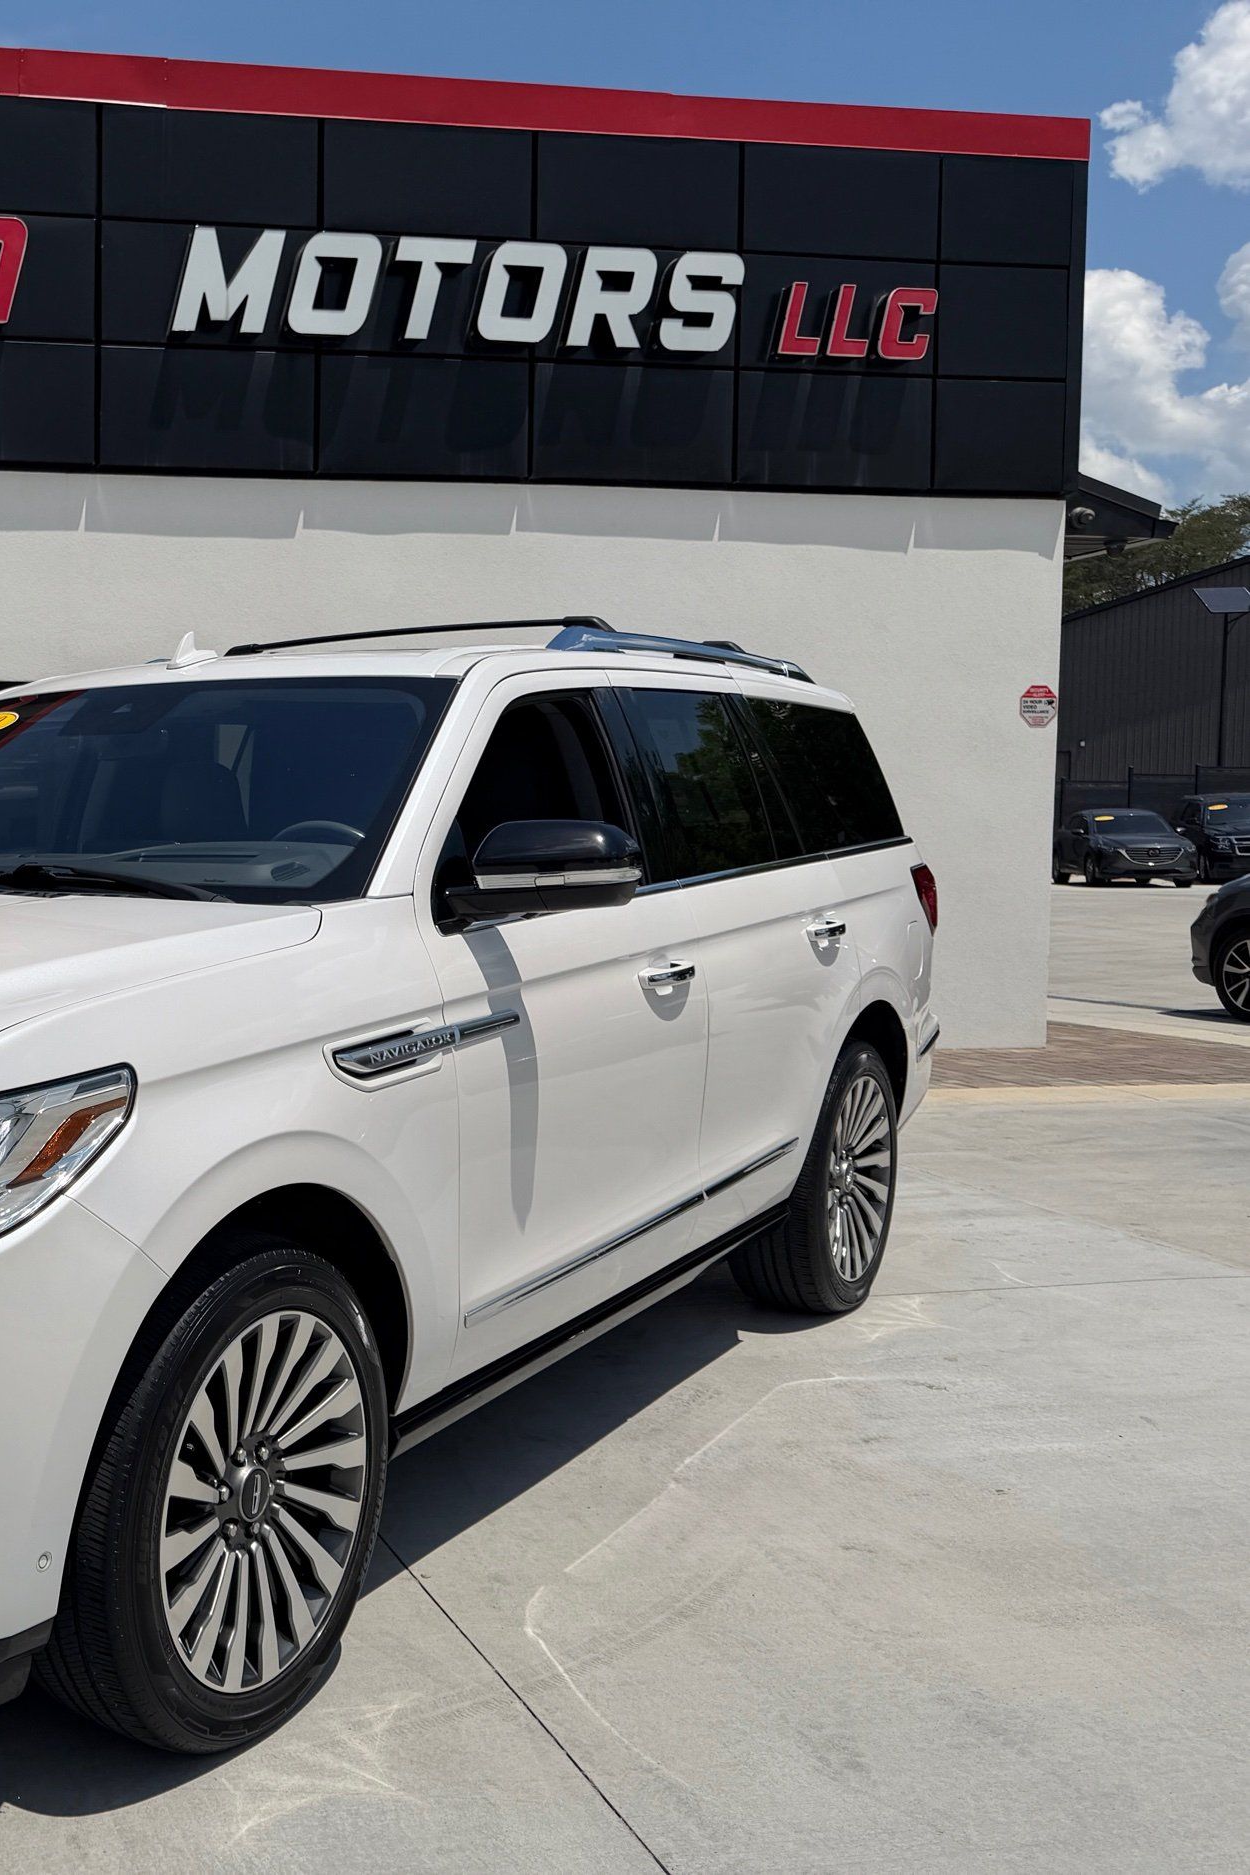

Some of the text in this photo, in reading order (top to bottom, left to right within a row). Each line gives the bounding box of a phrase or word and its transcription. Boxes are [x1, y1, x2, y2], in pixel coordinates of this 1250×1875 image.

[171, 224, 746, 352] MOTORS
[776, 281, 939, 361] LLC
[369, 1032, 453, 1064] NAVIGATOR
